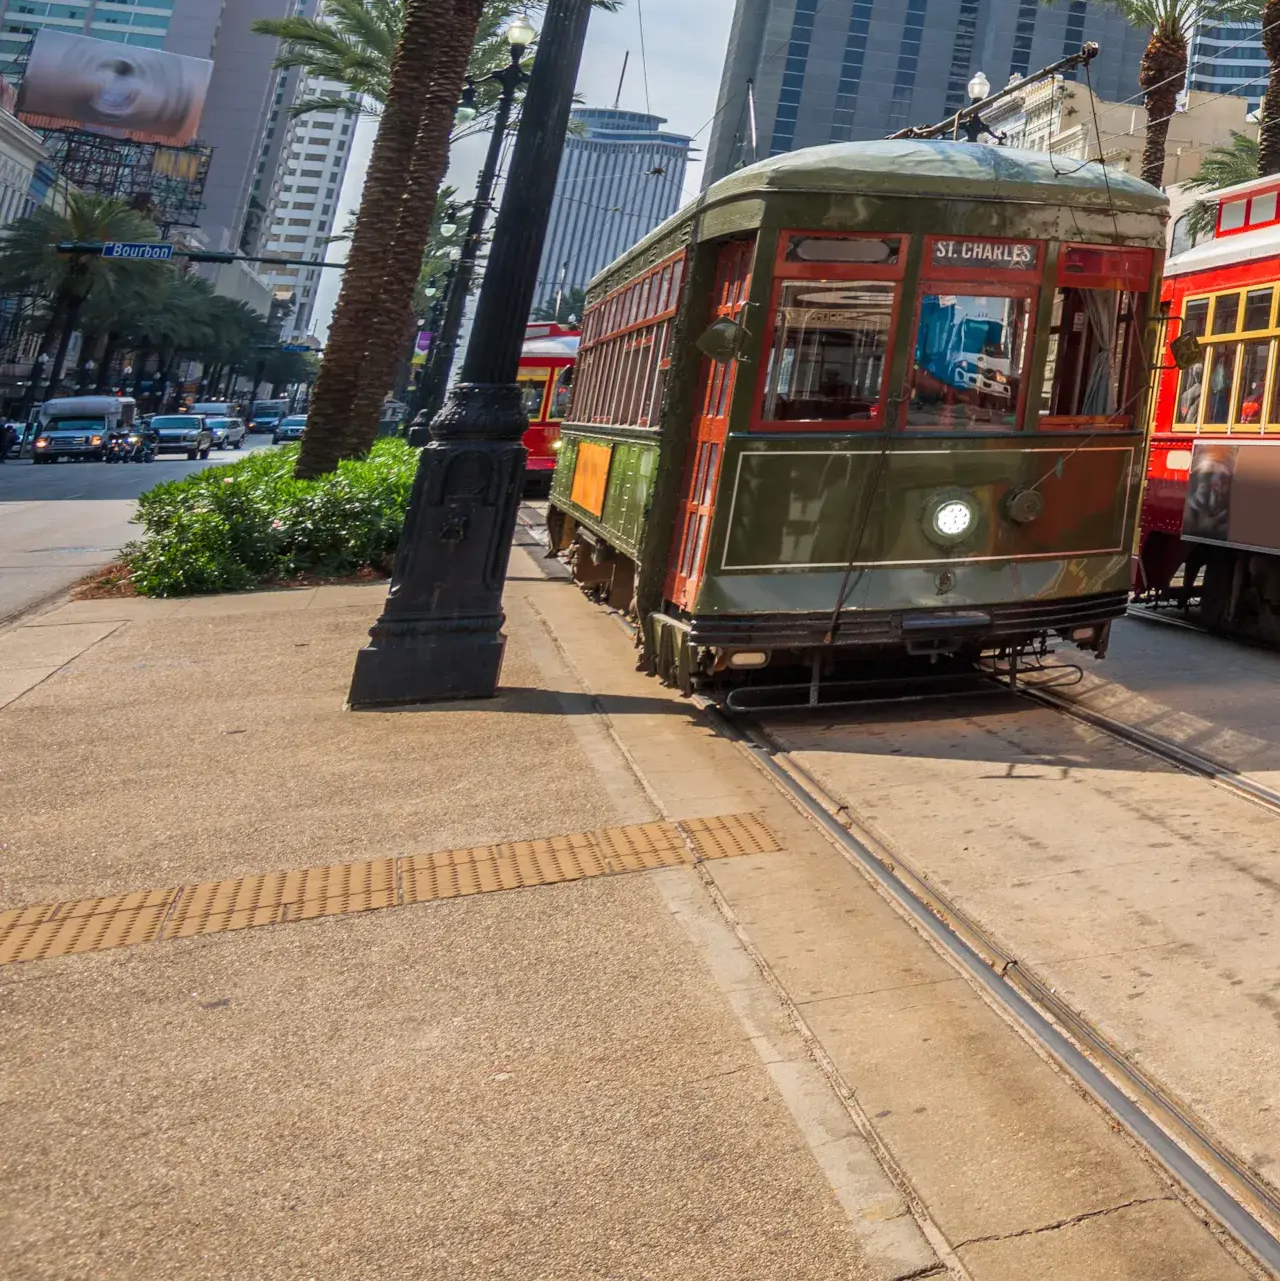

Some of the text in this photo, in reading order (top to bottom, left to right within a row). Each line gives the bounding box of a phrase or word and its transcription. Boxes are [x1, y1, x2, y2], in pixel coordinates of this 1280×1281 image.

[113, 244, 168, 258] Bourbon
[936, 241, 1031, 262] ST. CHARLES
